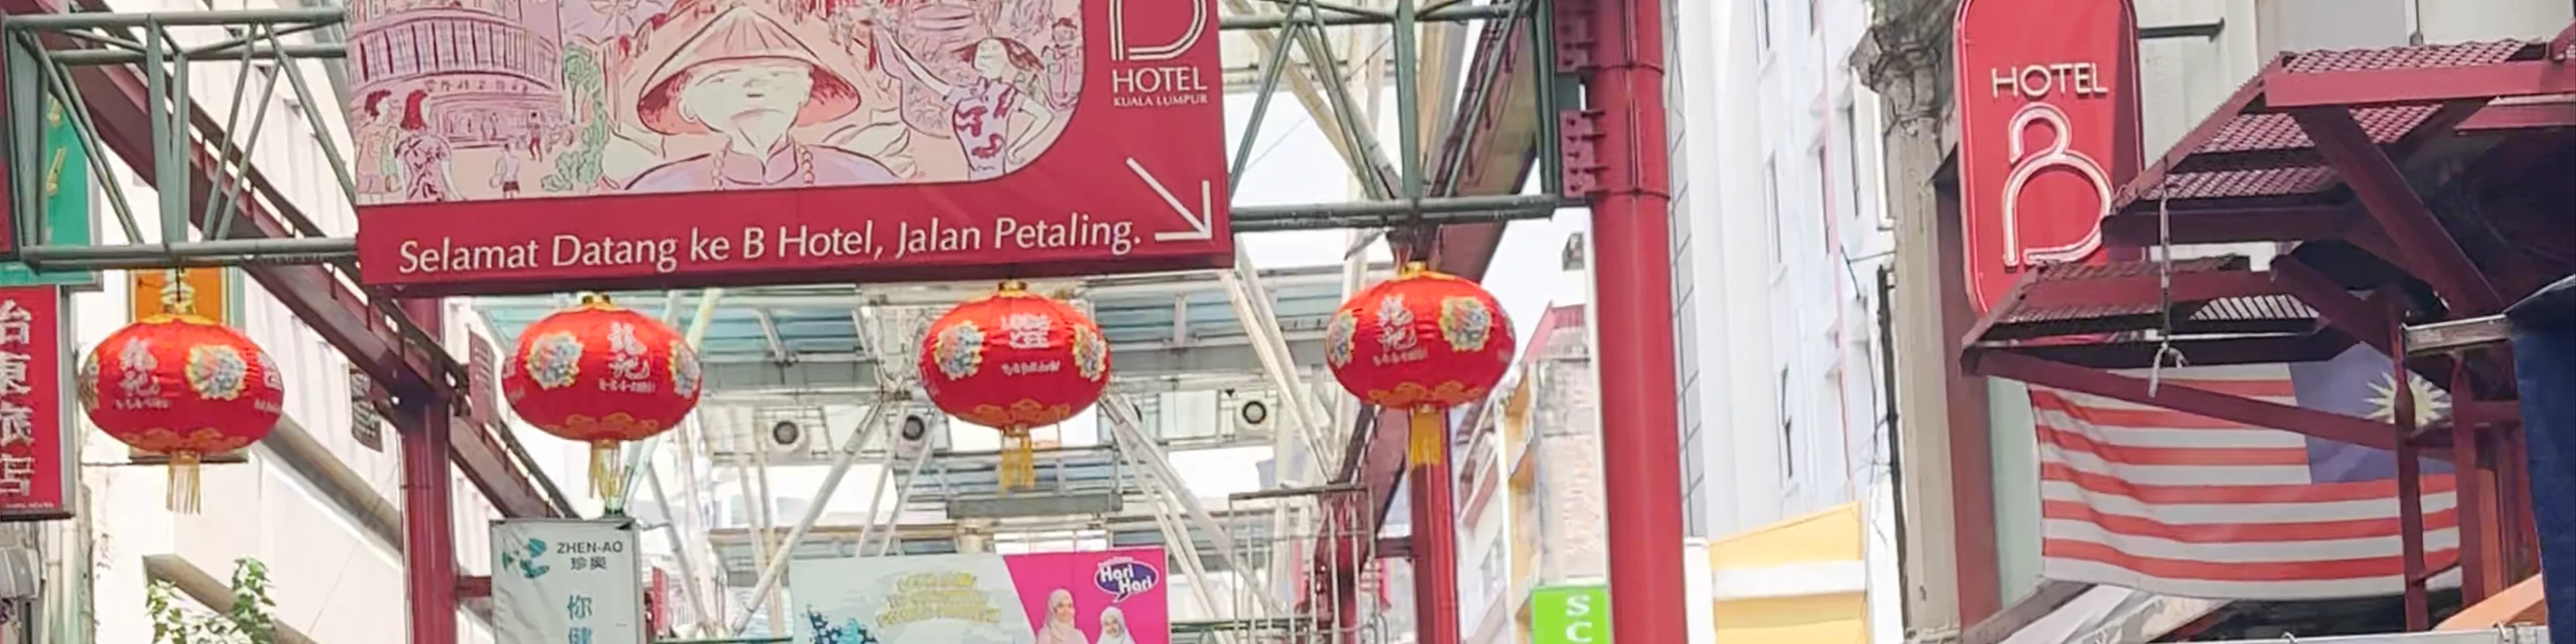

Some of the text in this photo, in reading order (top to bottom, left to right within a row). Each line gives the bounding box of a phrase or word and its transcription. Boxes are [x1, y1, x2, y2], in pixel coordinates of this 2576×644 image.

[1112, 65, 1208, 93] HOTEL
[1991, 62, 2108, 97] HOTEL
[1114, 94, 1208, 107] KUALA LUMPUR
[398, 212, 1141, 273] Selamat Datang ke B Hotel, Jalan Petaling.
[557, 541, 623, 554] ZHEN-AO
[1100, 564, 1134, 582] Hari
[1119, 575, 1153, 594] Hari
